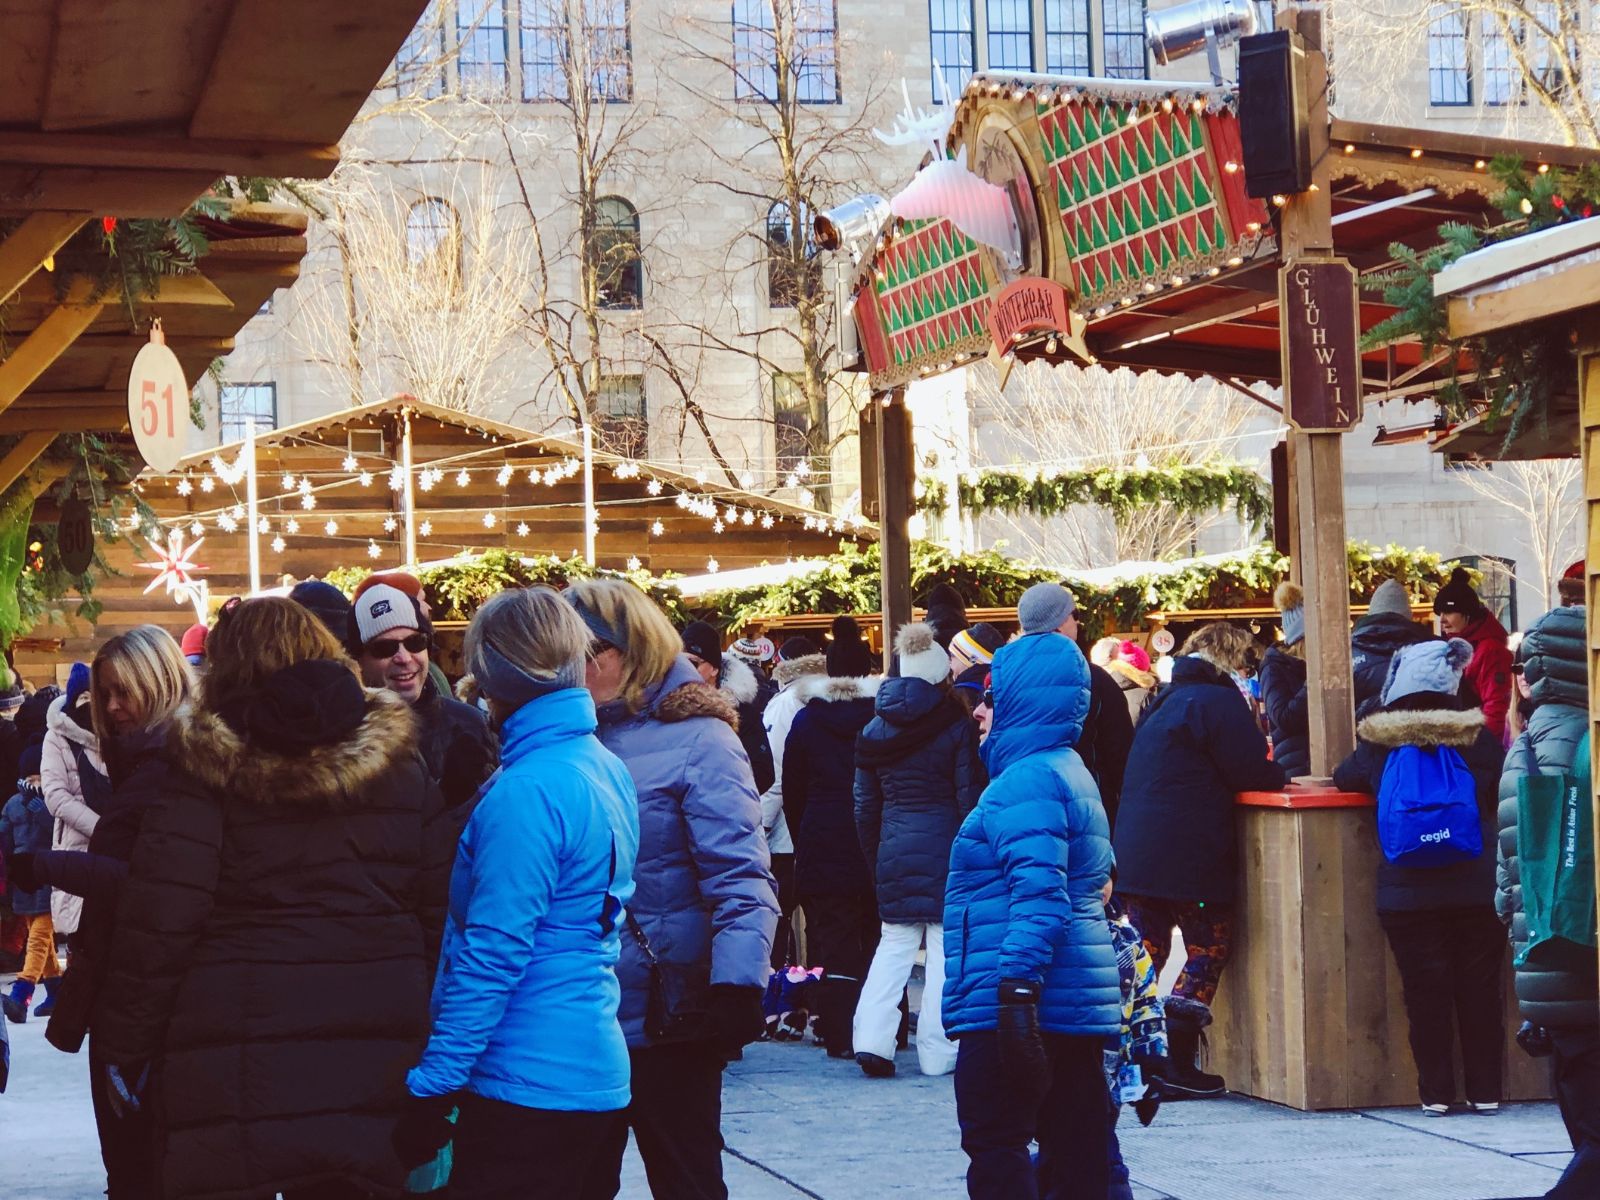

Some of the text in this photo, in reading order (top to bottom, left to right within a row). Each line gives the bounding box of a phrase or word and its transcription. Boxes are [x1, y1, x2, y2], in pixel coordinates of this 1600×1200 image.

[1295, 268, 1350, 423] GLÜHWEIN
[140, 380, 175, 439] 51
[64, 519, 87, 553] 50
[1568, 786, 1578, 806] Fresh
[1567, 808, 1576, 828] Asian
[1420, 827, 1451, 843] cegid
[1566, 837, 1575, 852] Best
[1564, 853, 1574, 867] The
